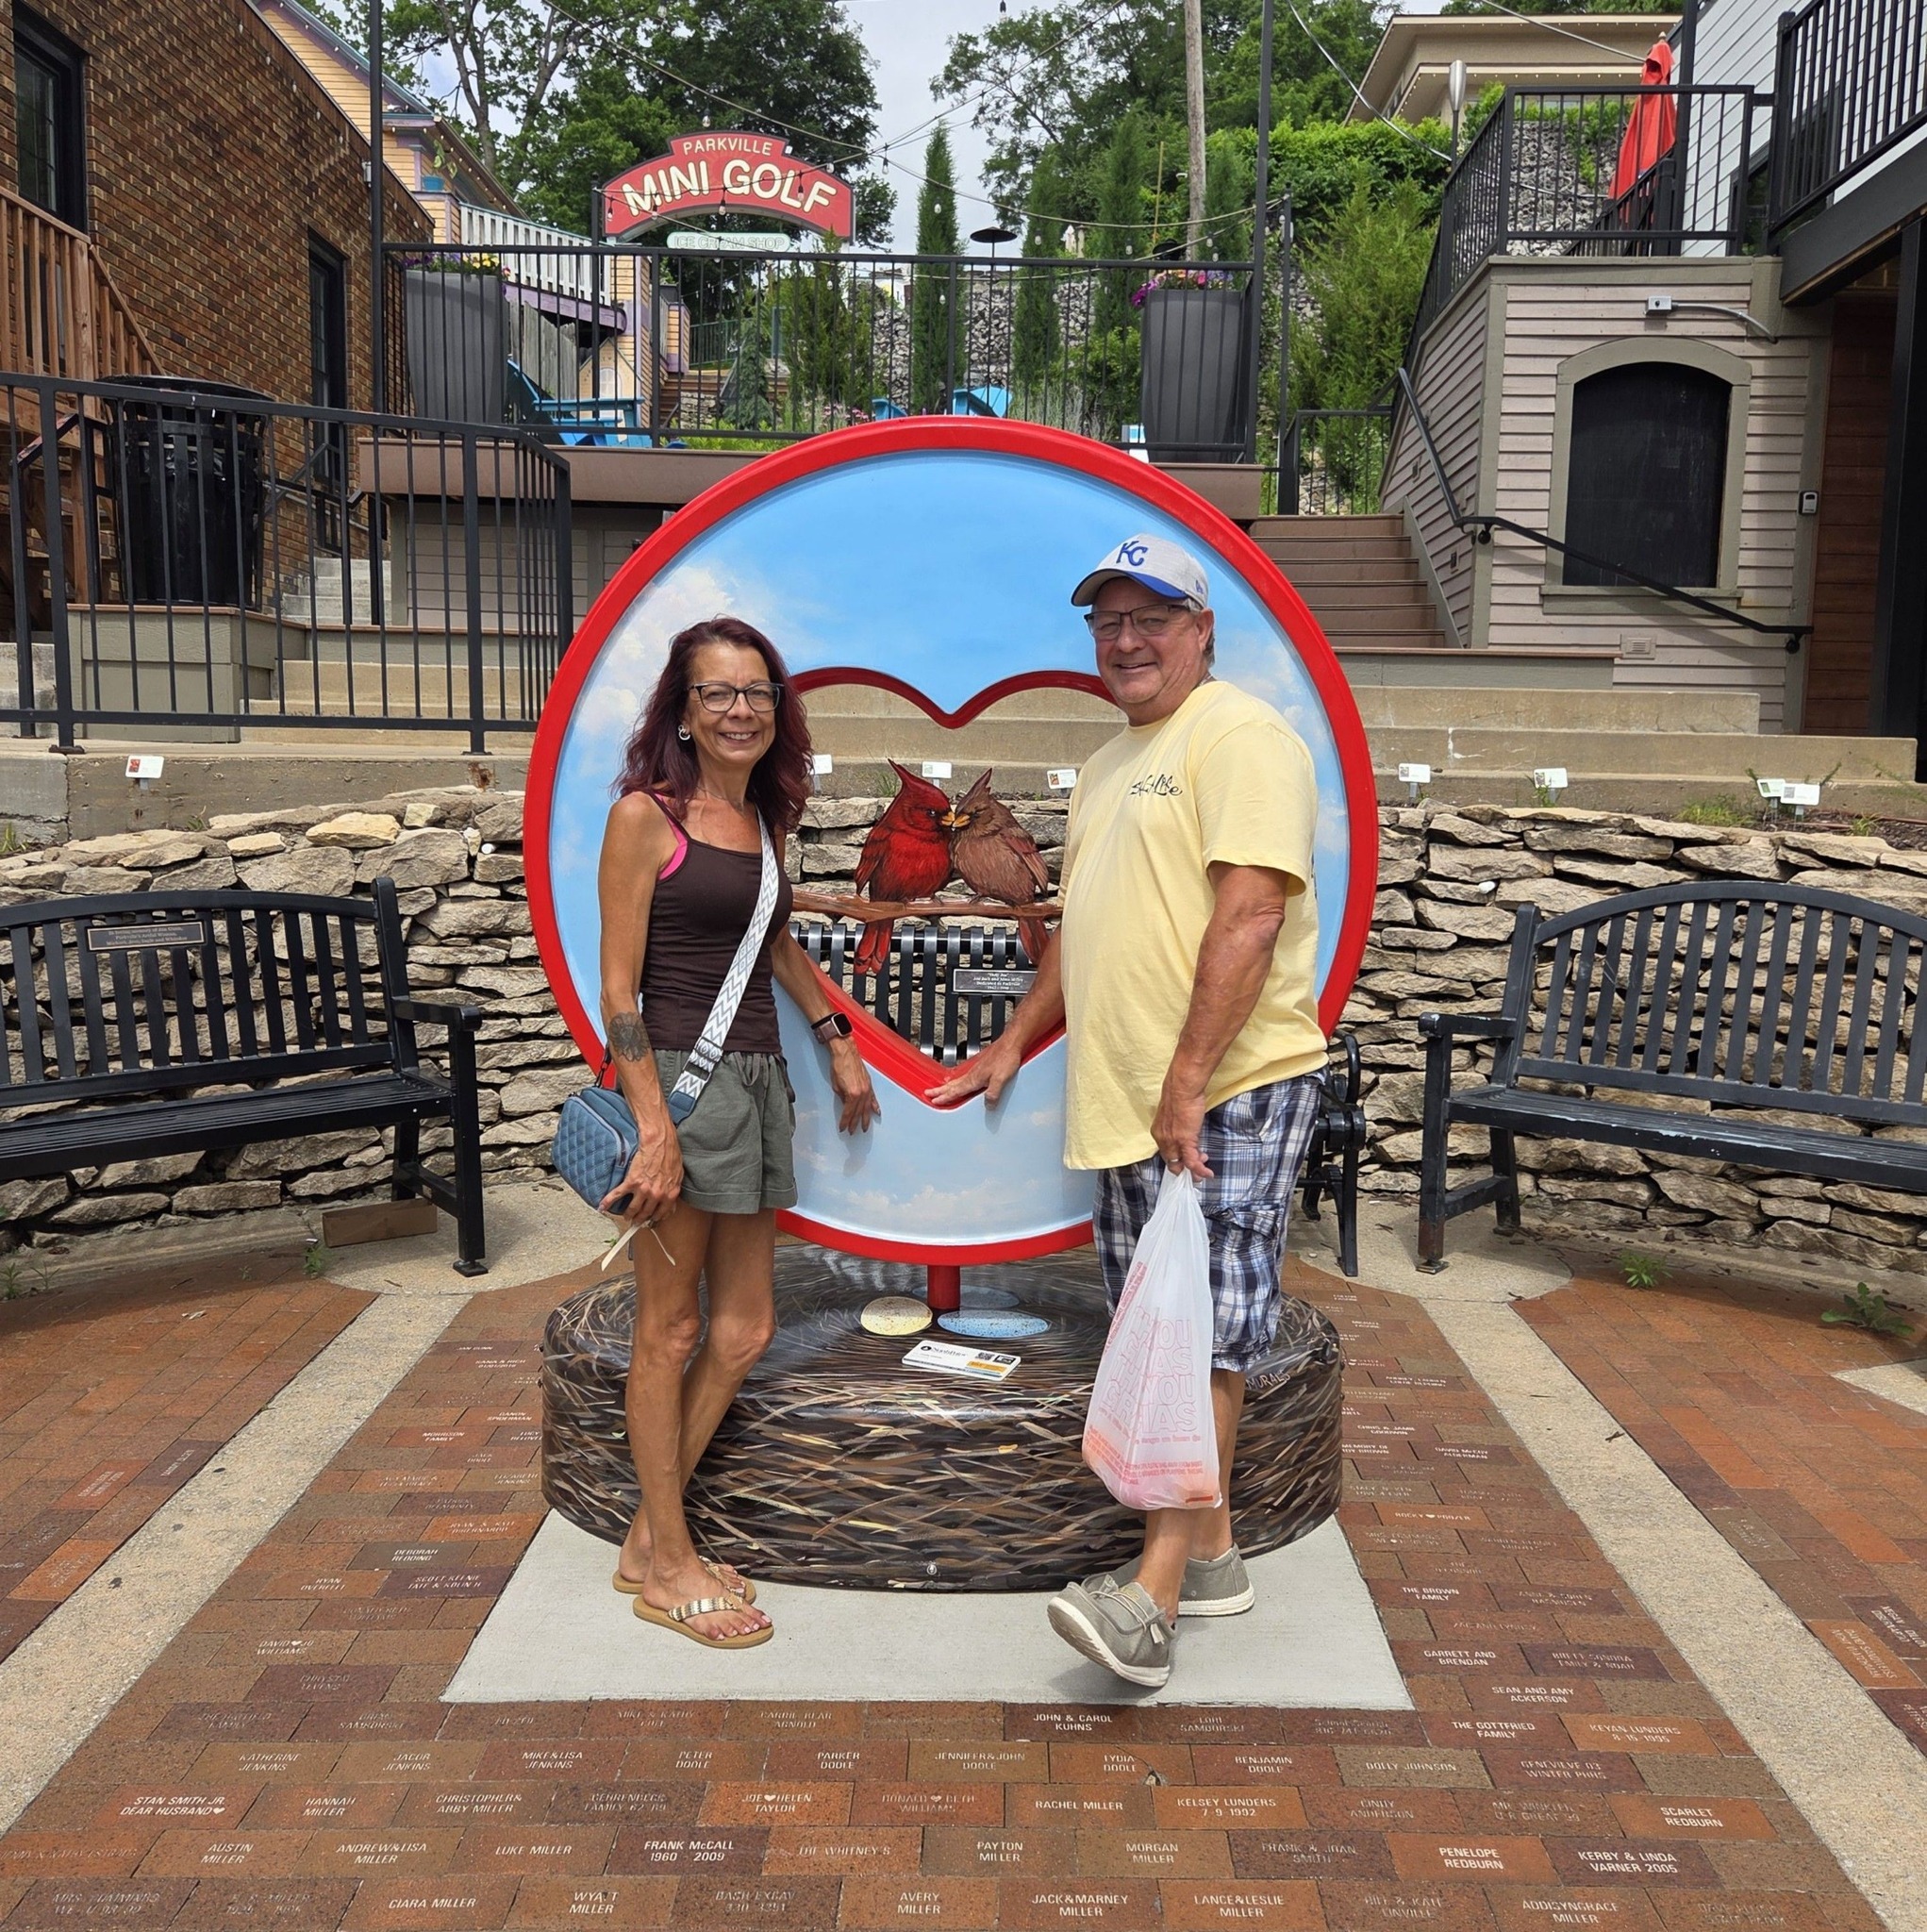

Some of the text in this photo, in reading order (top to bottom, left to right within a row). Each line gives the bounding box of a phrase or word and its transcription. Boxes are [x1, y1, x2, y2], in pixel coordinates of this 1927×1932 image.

[683, 137, 773, 156] PARKVILLE
[621, 158, 837, 216] MINI GOLF
[673, 236, 696, 248] ICE
[747, 237, 785, 249] SHOP
[1116, 541, 1149, 566] KC
[1524, 1687, 1547, 1695] AND
[1551, 1688, 1575, 1696] AMY
[1510, 1695, 1568, 1704] ACKERSON
[1079, 1714, 1112, 1723] CAROL
[1452, 1722, 1536, 1731] THE GOTTFRIED
[1589, 1724, 1681, 1735] KEYAN LUNDERS
[1477, 1730, 1517, 1739] FAMILY
[393, 1753, 431, 1761] JACOB
[678, 1751, 713, 1759] PETER
[817, 1752, 860, 1760] PARKER
[1104, 1755, 1135, 1763] LYDIA
[675, 1760, 710, 1769] DOOLE
[1235, 1756, 1293, 1764] BENJAMIN
[382, 1762, 431, 1771] JENKINS
[524, 1761, 573, 1770] JENKINS
[820, 1761, 856, 1770] DOOLE
[962, 1761, 997, 1771] DOOLE
[1104, 1764, 1137, 1773] DOOLE
[1248, 1765, 1284, 1774] DOOLE
[1366, 1762, 1457, 1772] DOLLY JOHNSON
[1525, 1770, 1571, 1779] WINTER
[134, 1796, 225, 1805] STAN SMITH JR.
[306, 1797, 357, 1806] HANNAH
[742, 1794, 812, 1803] JOE HELEN
[882, 1794, 927, 1803] DONALD
[1177, 1798, 1276, 1807] KELSEY LUNDERS
[437, 1804, 514, 1813] ABBY MILLER
[756, 1805, 795, 1813] TAYLOR
[1036, 1801, 1123, 1810] RACHEL MILLER
[120, 1807, 213, 1815] DEAR HUSBAND
[303, 1807, 345, 1816] MILLER
[1351, 1809, 1414, 1819] ANDERSON
[1660, 1807, 1713, 1817] SCARLET
[1665, 1817, 1723, 1827] REDBURN
[208, 1843, 254, 1852] AUSTIN
[336, 1843, 427, 1852] ANDREW&LISA
[644, 1840, 734, 1850] FRANK McCALL
[976, 1841, 1023, 1851] PAYTON
[1126, 1842, 1179, 1852] MORGAN
[495, 1845, 573, 1856] LUKE MILLER
[1439, 1847, 1500, 1858] PENELOPE
[201, 1855, 244, 1863] MILLER
[354, 1855, 398, 1863] MILLER
[650, 1852, 724, 1861] 1960 2009
[979, 1853, 1021, 1862] MILLER
[1132, 1855, 1174, 1863] MILLER
[1578, 1851, 1677, 1862] KERBY & LINDA
[1444, 1858, 1503, 1870] REDBURN
[1590, 1862, 1678, 1874] VARNER 2005
[900, 1892, 939, 1902] AVERY
[1031, 1894, 1128, 1905] JACK&MARNEY
[1194, 1895, 1284, 1905] LANCE&LESLIE
[389, 1898, 476, 1908] CIARA MILLER
[569, 1904, 614, 1913] MILLER
[897, 1905, 940, 1914] MILLER
[1059, 1907, 1103, 1916] MILLER
[1220, 1907, 1264, 1917] MILLER
[1553, 1914, 1599, 1924] MILLER
